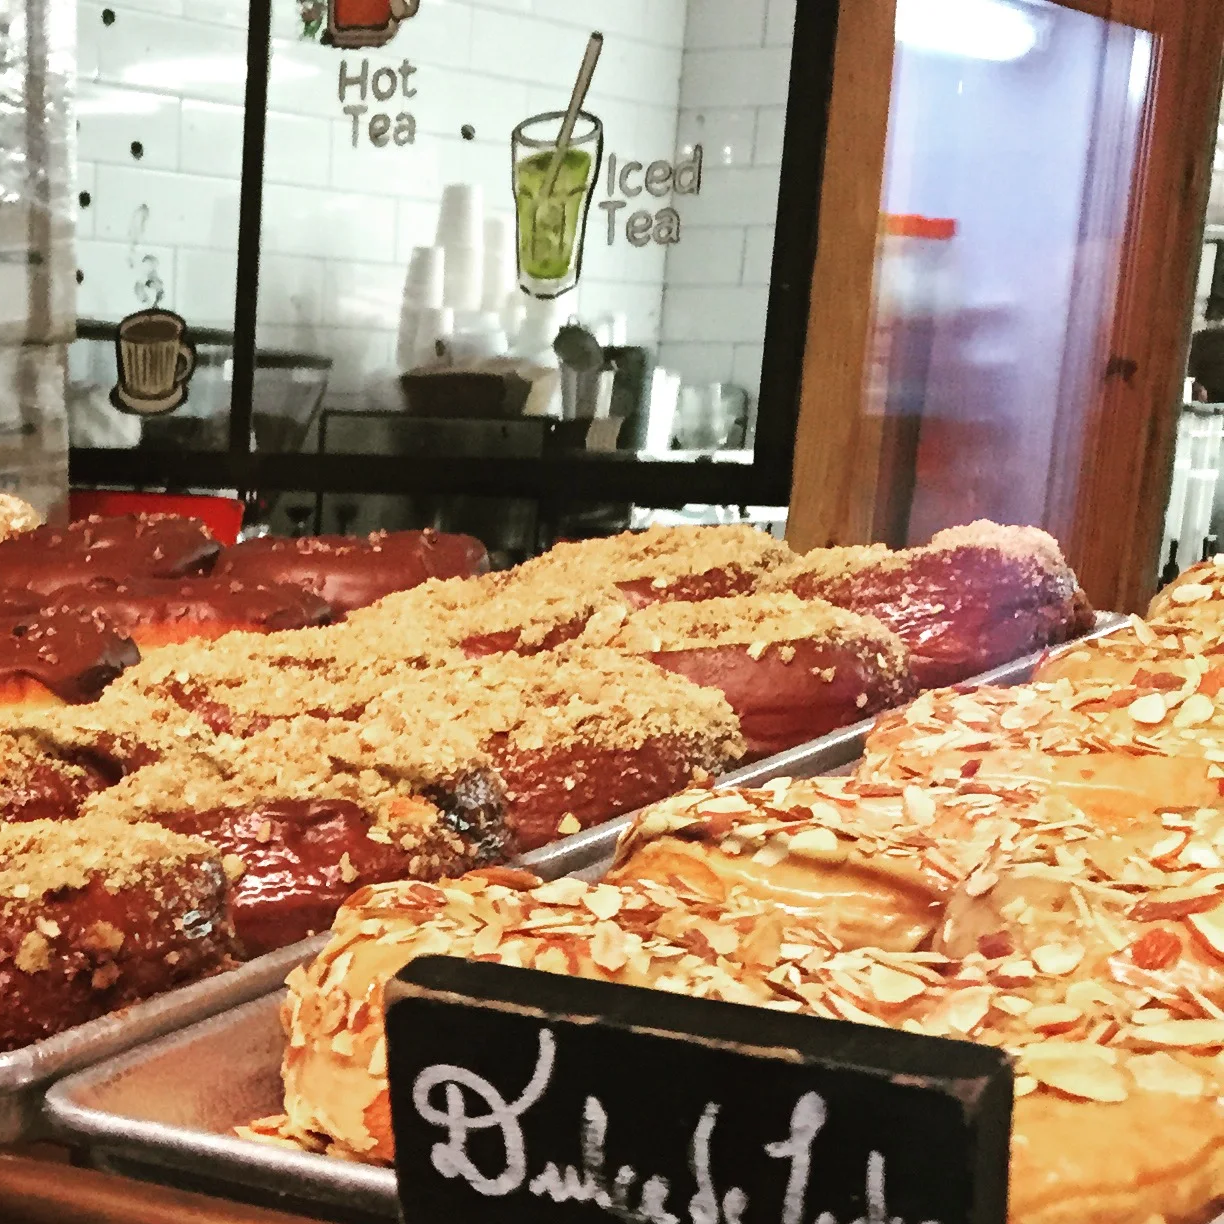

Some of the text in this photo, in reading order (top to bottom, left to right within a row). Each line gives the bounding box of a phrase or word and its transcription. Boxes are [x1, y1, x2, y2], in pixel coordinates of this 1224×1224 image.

[338, 58, 418, 103] Hot
[343, 104, 416, 149] Tea
[607, 143, 703, 198] Iced
[598, 200, 681, 247] Tea
